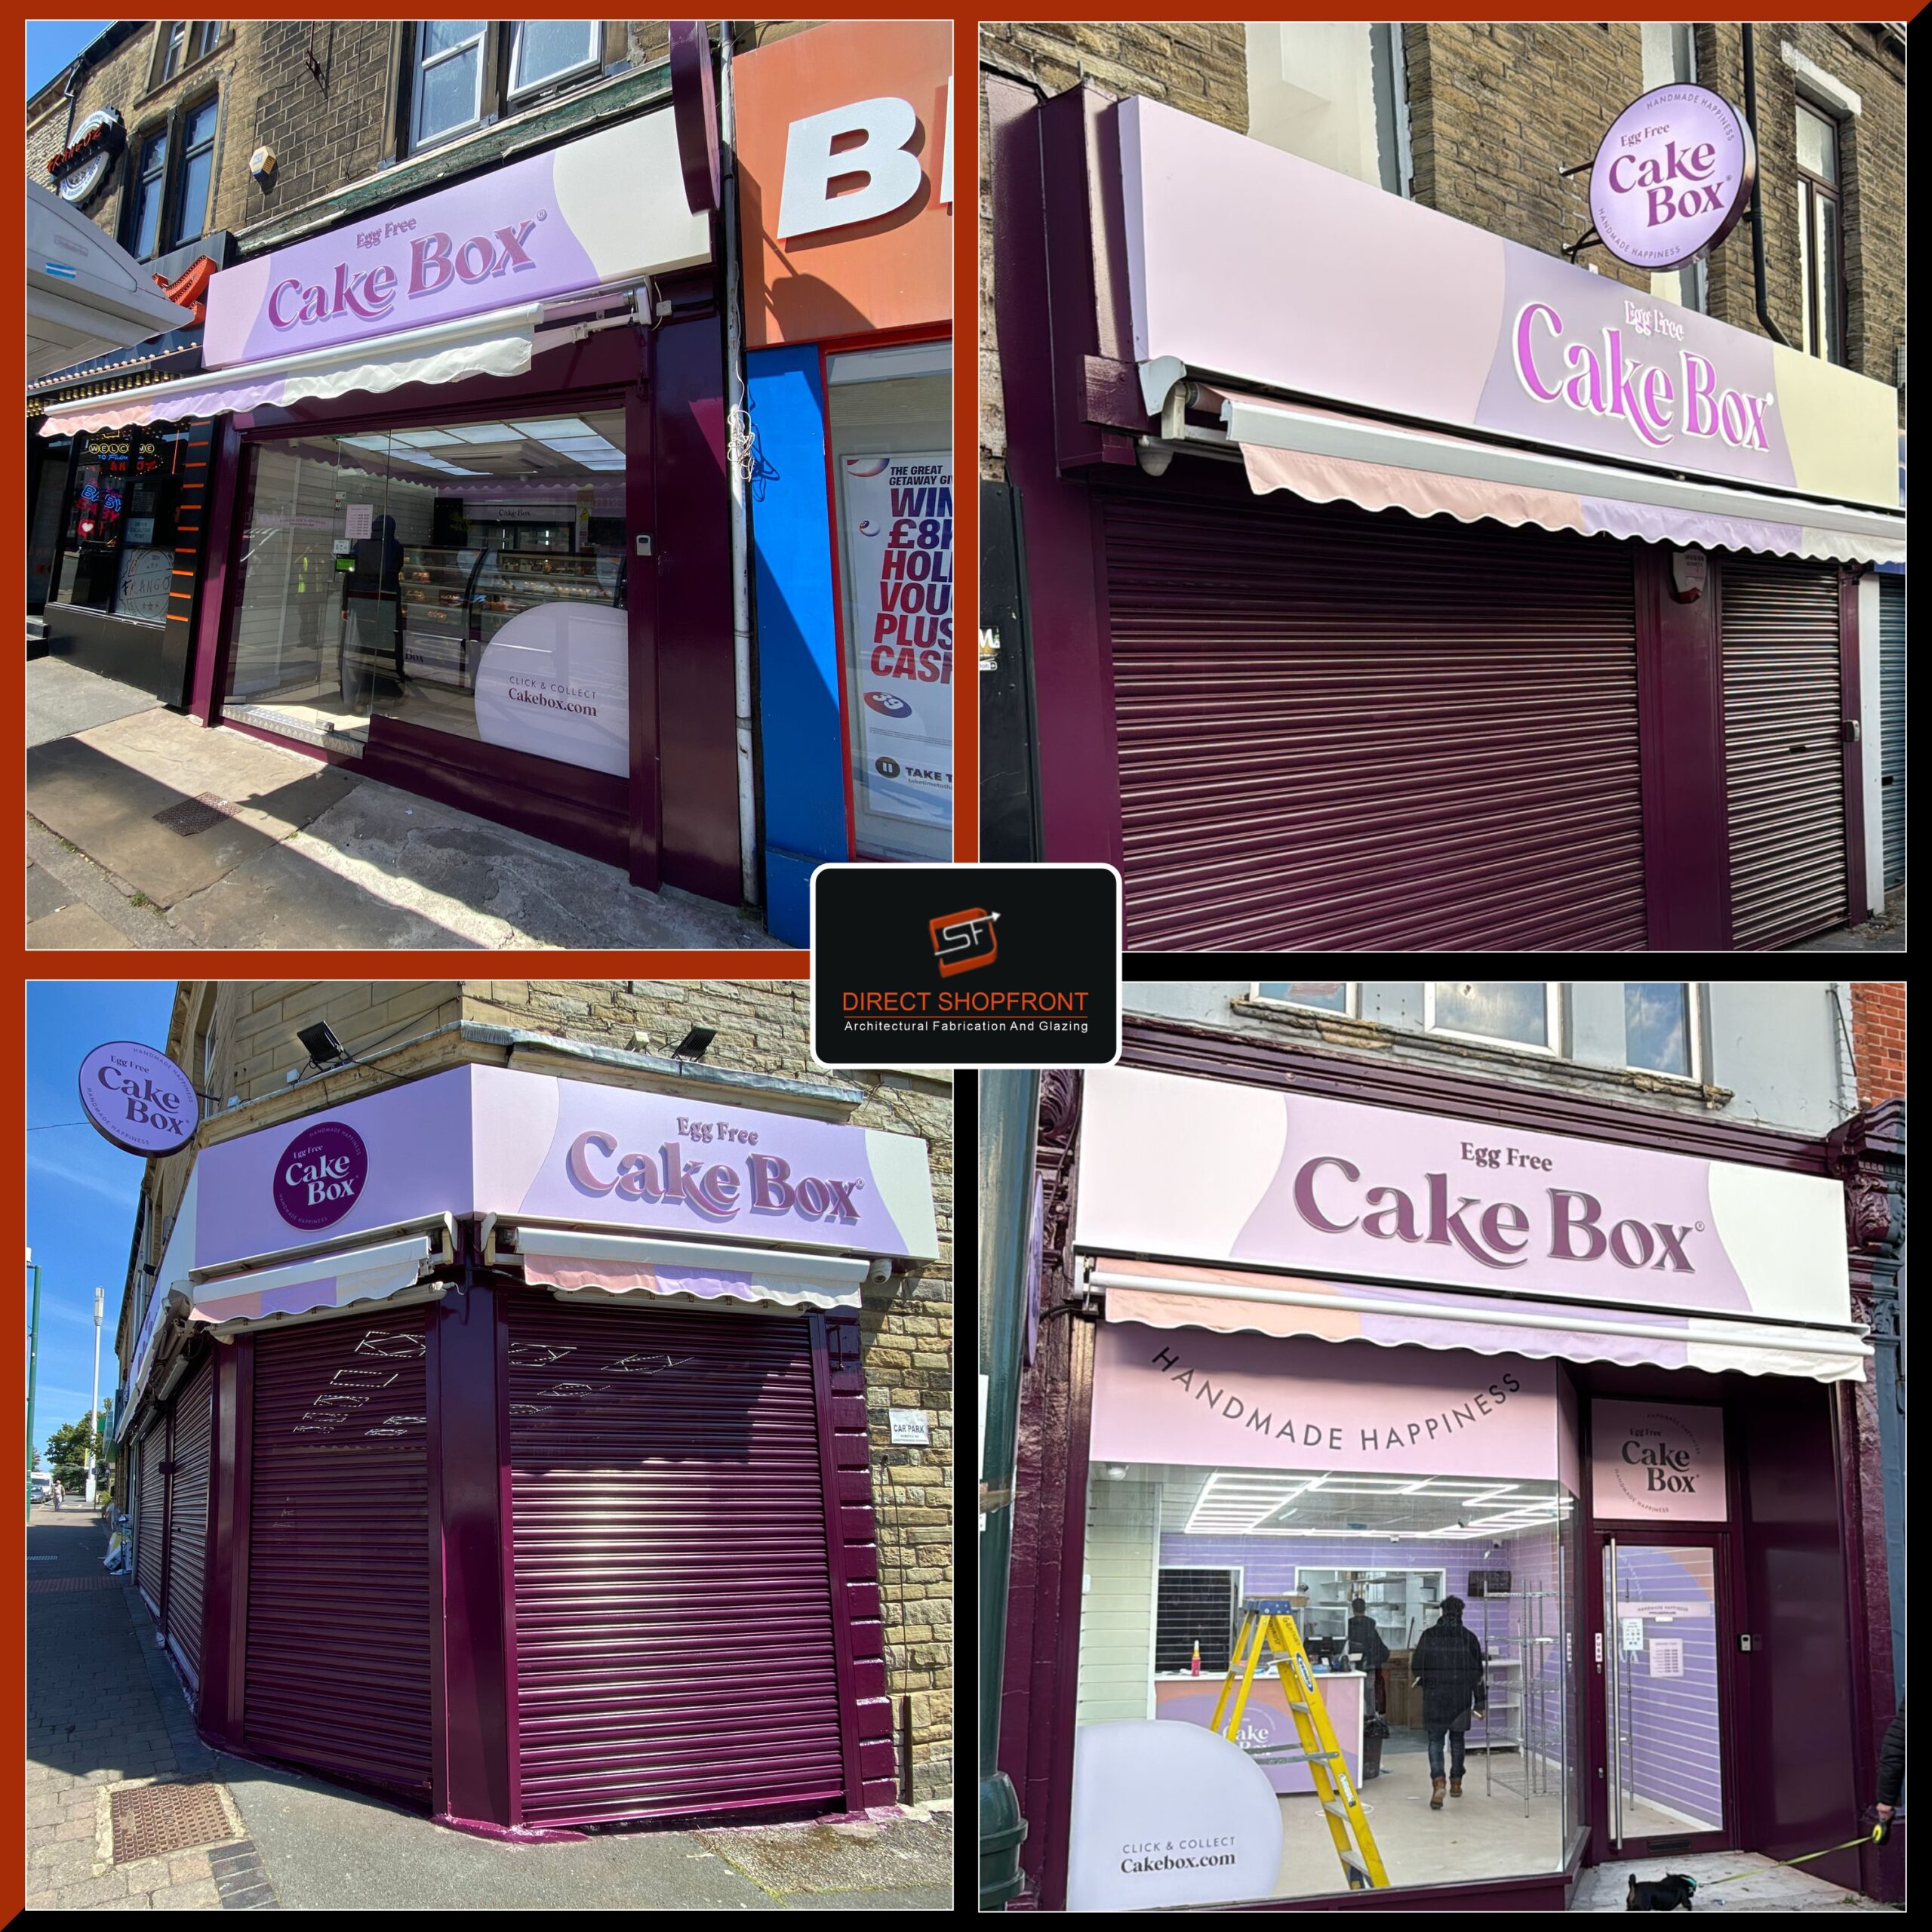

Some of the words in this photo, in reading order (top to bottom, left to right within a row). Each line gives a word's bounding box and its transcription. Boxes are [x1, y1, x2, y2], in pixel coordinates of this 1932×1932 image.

[1647, 93, 1699, 109] HANDMADE
[1702, 98, 1734, 142] HAPPINESS
[1621, 132, 1641, 147] Egg
[1644, 124, 1670, 139] Free
[1609, 141, 1715, 194] Cake
[356, 228, 382, 249] Egg
[384, 217, 417, 238] Free
[1598, 208, 1630, 253] HANDMADE
[1632, 245, 1681, 259] HAPPINESS
[268, 262, 398, 331] Cake
[1624, 300, 1652, 337] Egg
[1654, 309, 1684, 342] Free
[1512, 301, 1675, 448] Cake
[89, 443, 155, 454] WELCME
[889, 475, 937, 485] GETAWAY
[890, 466, 909, 476] THE
[911, 465, 943, 475] GREAT
[498, 509, 517, 518] Cake
[517, 509, 531, 517] Box
[880, 581, 952, 615] VOU
[874, 613, 952, 651] PLUS
[508, 688, 598, 716] Cakebox.com
[509, 675, 537, 688] CLICK
[540, 681, 546, 690] &
[551, 684, 596, 699] COLLECT
[872, 692, 904, 710] 39
[905, 767, 942, 781] TAKE
[111, 1055, 128, 1067] Egg
[130, 1060, 149, 1074] Free
[133, 1048, 172, 1069] HANDMADE
[172, 1069, 194, 1103] HAPPINESS
[98, 1066, 180, 1114] Cake
[86, 1088, 110, 1124] HANDMADE
[111, 1124, 151, 1146] HAPPINESS
[676, 1116, 713, 1143] Egg
[716, 1121, 759, 1146] Free
[294, 1149, 306, 1159] Egg
[307, 1145, 323, 1154] Free
[309, 1128, 341, 1137] HANDMADE
[342, 1131, 361, 1155] HAPPINESS
[1460, 1141, 1501, 1169] Egg
[1506, 1146, 1553, 1172] Free
[285, 1155, 350, 1186] Cake
[566, 1130, 741, 1223] Cake
[279, 1193, 297, 1220] HANDMADE
[1293, 1155, 1530, 1270] Cake
[1152, 1346, 1343, 1450] HANDMADE
[1361, 1373, 1521, 1451] HAPPINESS
[893, 1424, 906, 1432] CAR
[908, 1425, 924, 1433] PARK
[1630, 1428, 1644, 1437] Egg
[1645, 1428, 1663, 1437] Free
[1622, 1440, 1690, 1472] Cake
[1614, 1469, 1636, 1503] HANDMADE
[1638, 1500, 1669, 1513] HAPPINESS
[1123, 1842, 1161, 1854] CLICK
[1165, 1841, 1174, 1850] &
[1179, 1836, 1235, 1849] COLLECT
[1121, 1854, 1236, 1874] Cakebox.com
